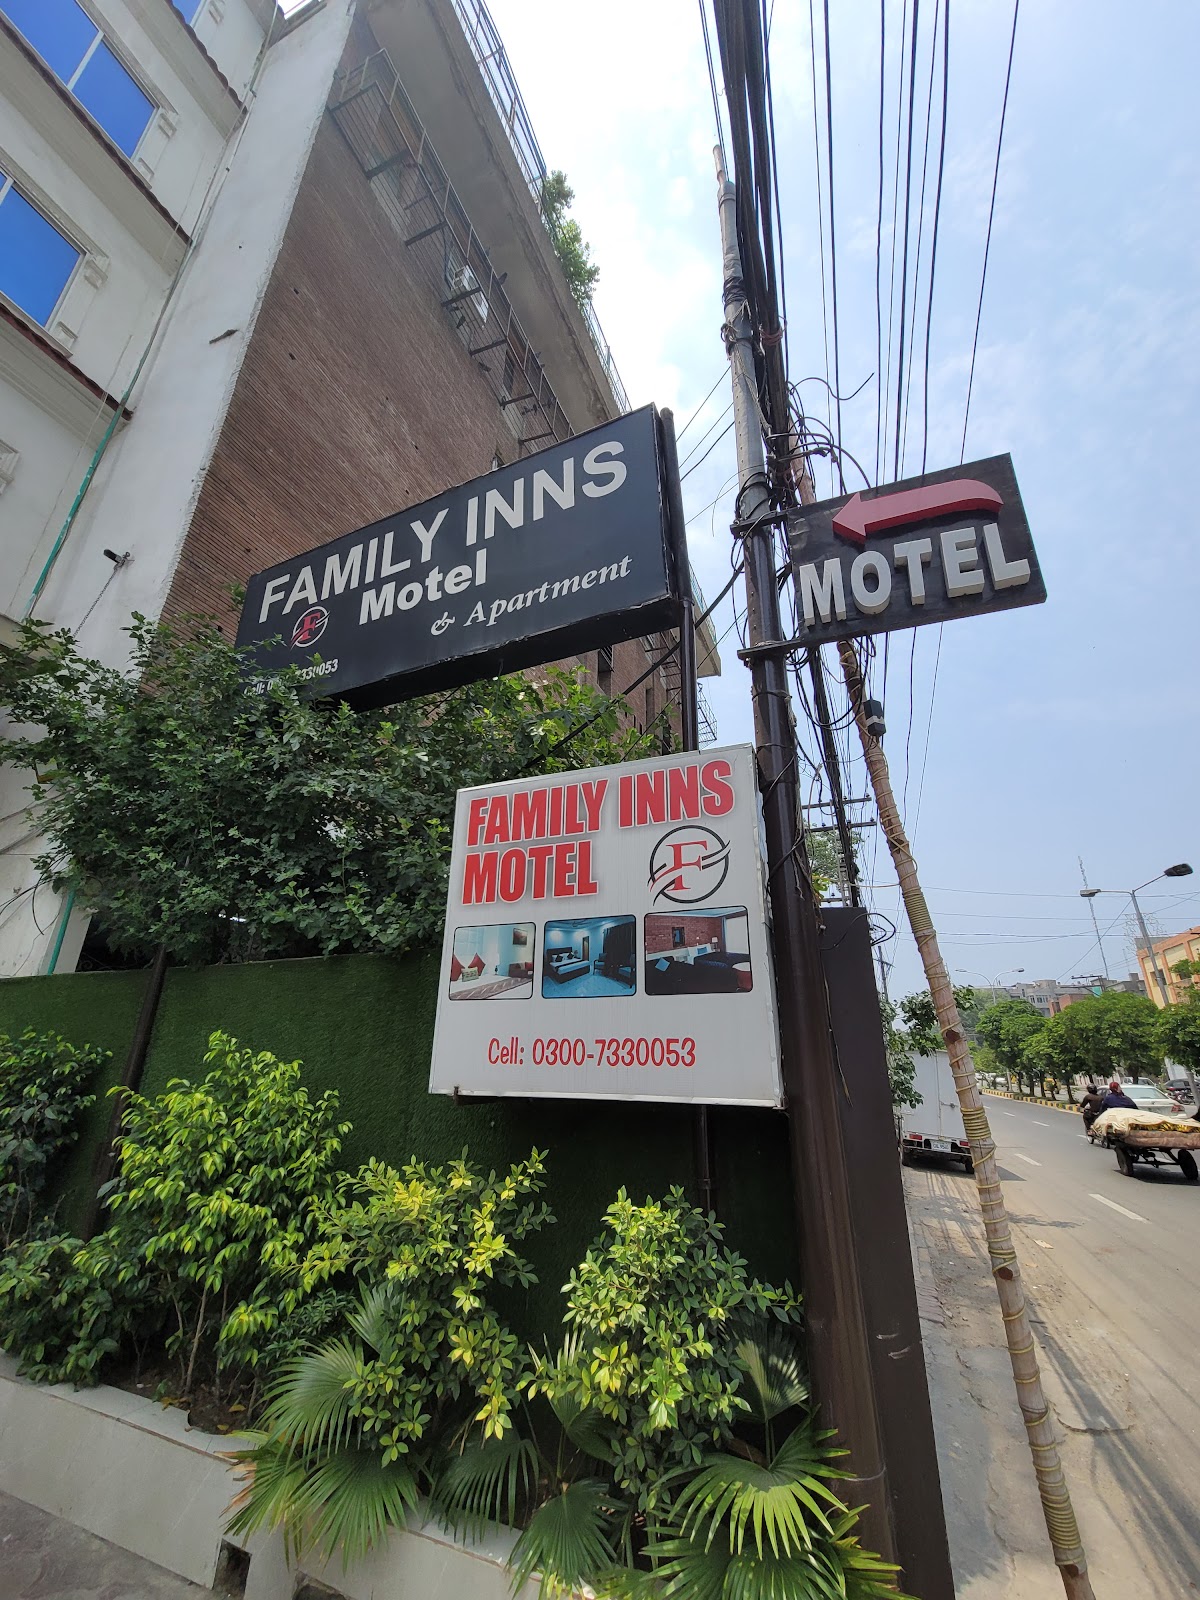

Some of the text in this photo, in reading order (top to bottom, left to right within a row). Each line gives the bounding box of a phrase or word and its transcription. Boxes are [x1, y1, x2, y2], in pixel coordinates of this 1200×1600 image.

[258, 441, 628, 623] FAMILY INNS
[358, 548, 488, 626] Motel
[430, 555, 633, 636] & Apartment
[799, 522, 1031, 627] MOTEL
[466, 759, 735, 848] FAMILY INNS
[461, 840, 599, 905] MOTEL
[488, 1037, 697, 1068] Cell: 0300-7330053
